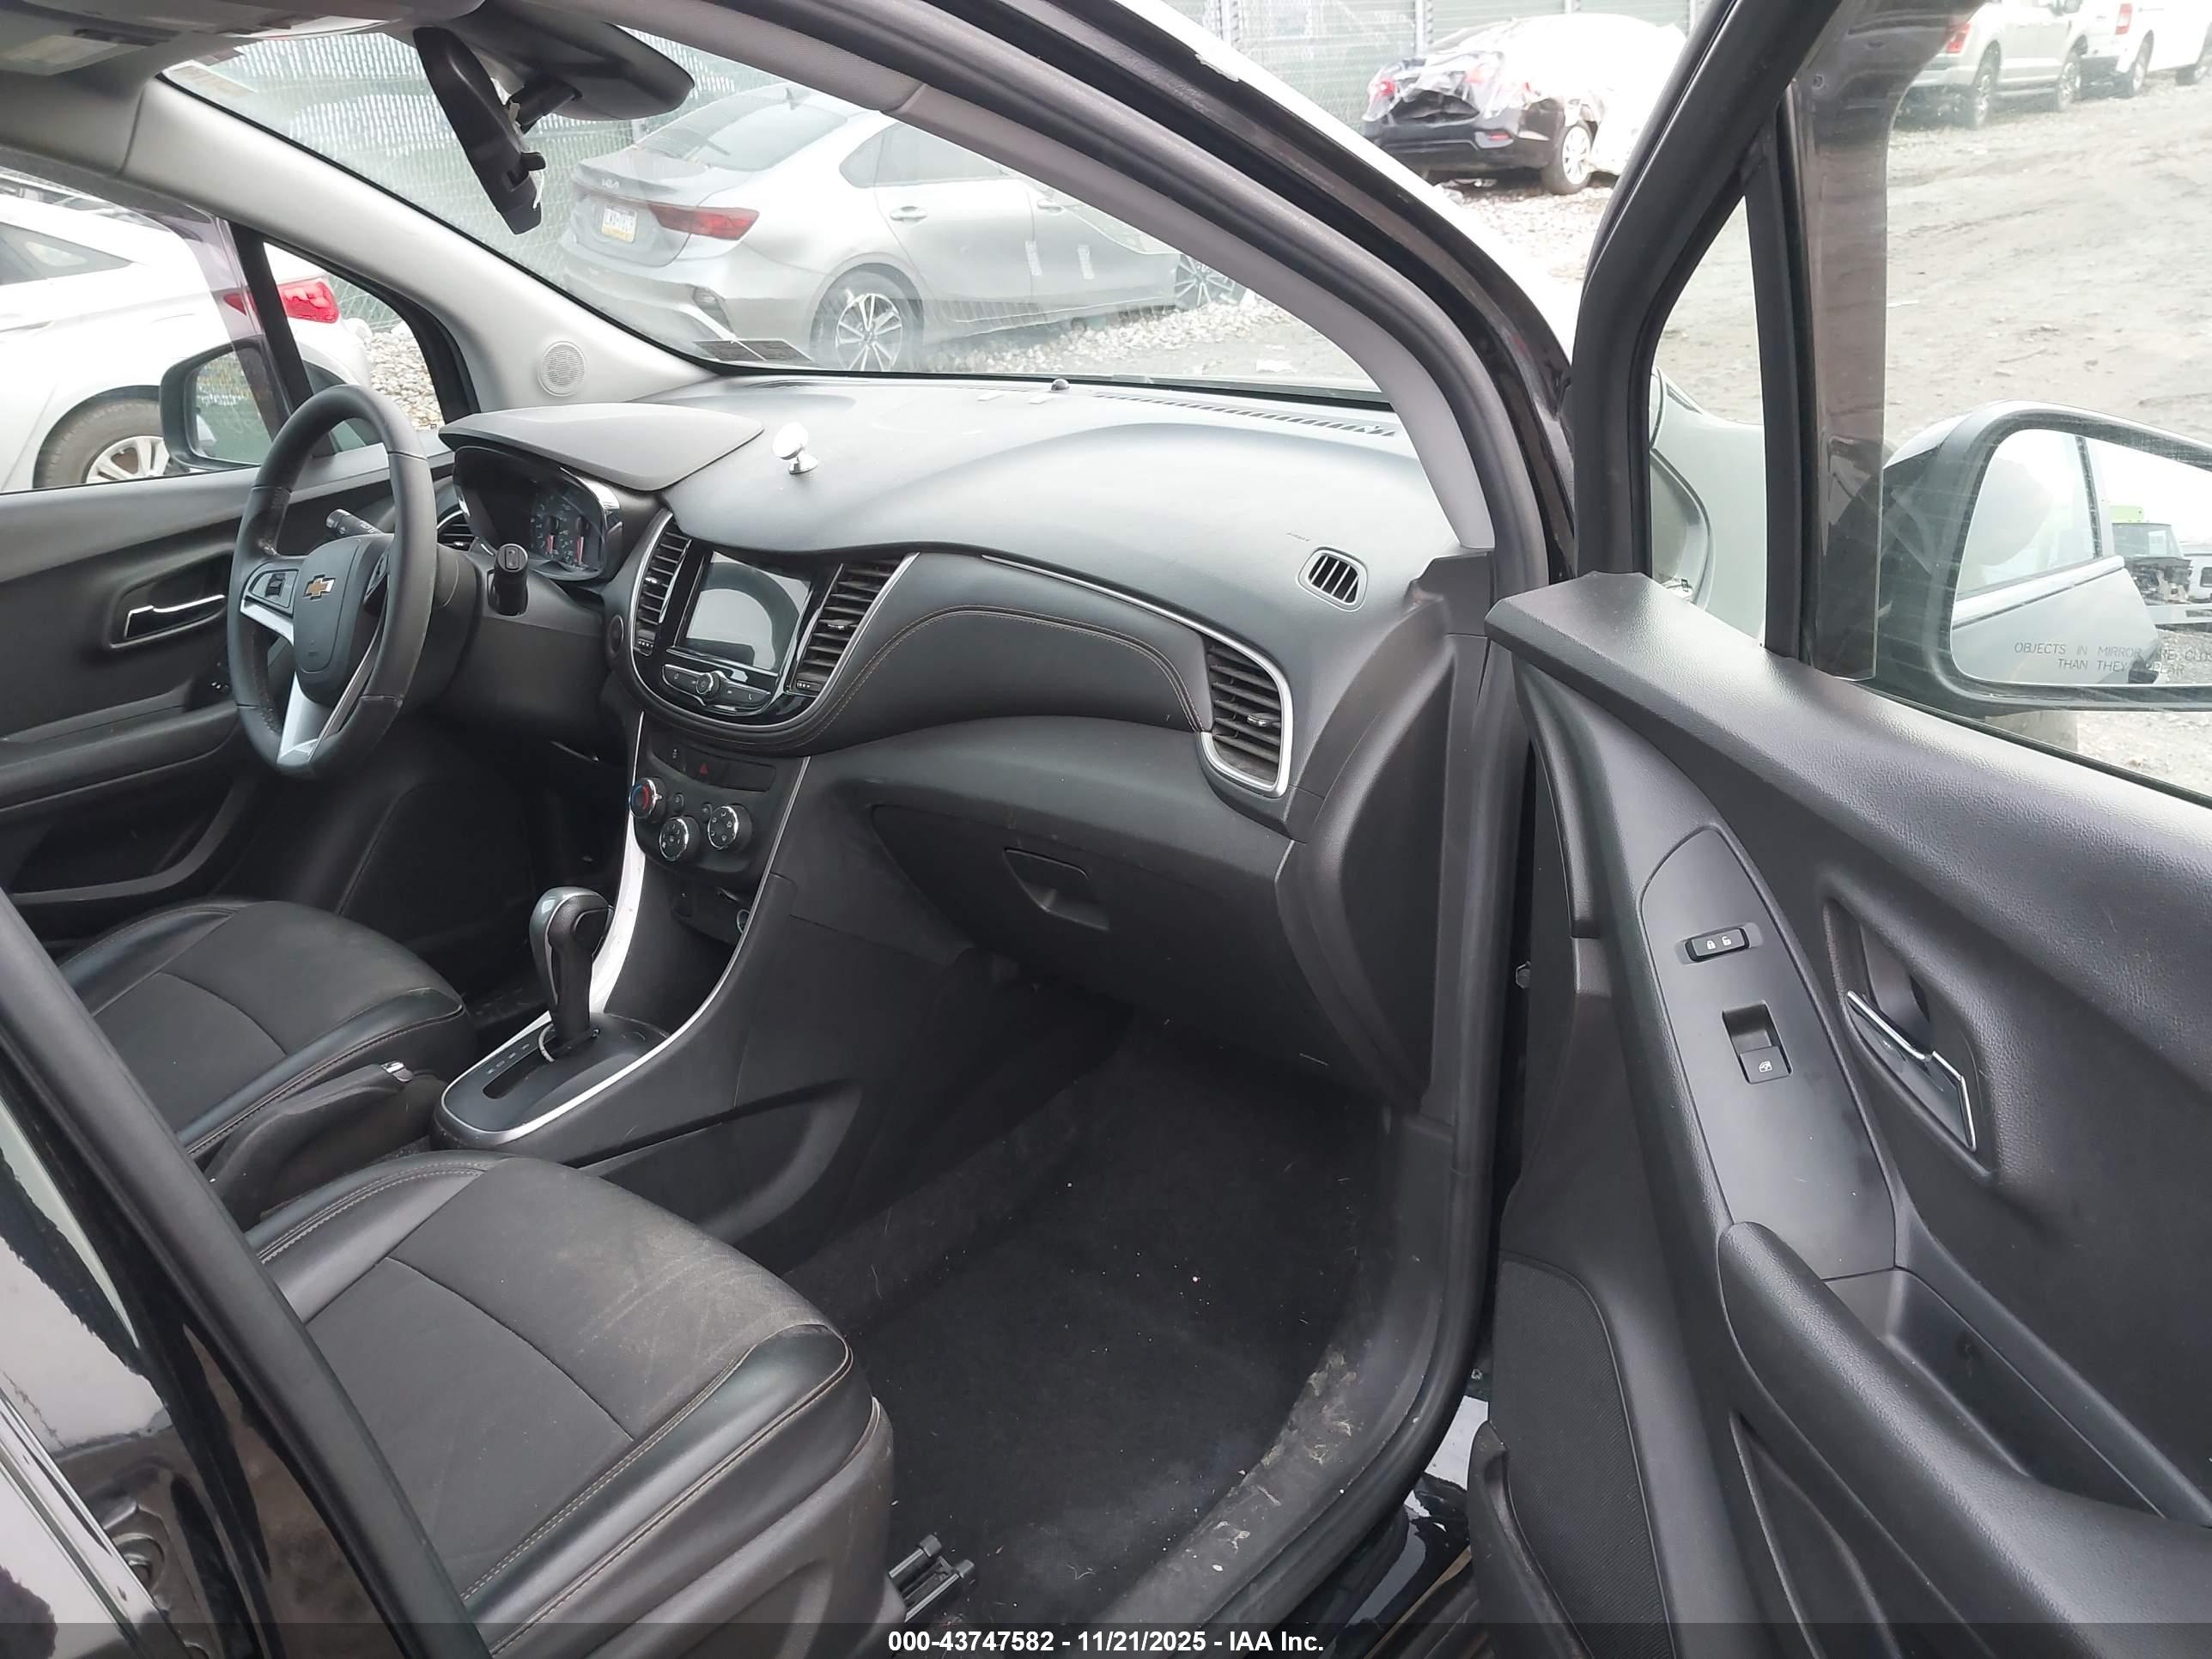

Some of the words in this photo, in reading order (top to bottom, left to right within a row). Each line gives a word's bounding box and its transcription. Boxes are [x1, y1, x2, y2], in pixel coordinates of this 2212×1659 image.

[2014, 641, 2067, 655] OBJECTS
[2075, 645, 2088, 656] IN
[2097, 646, 2142, 660] MIRROR
[2057, 658, 2088, 672] THAN
[2097, 660, 2129, 673] THEY
